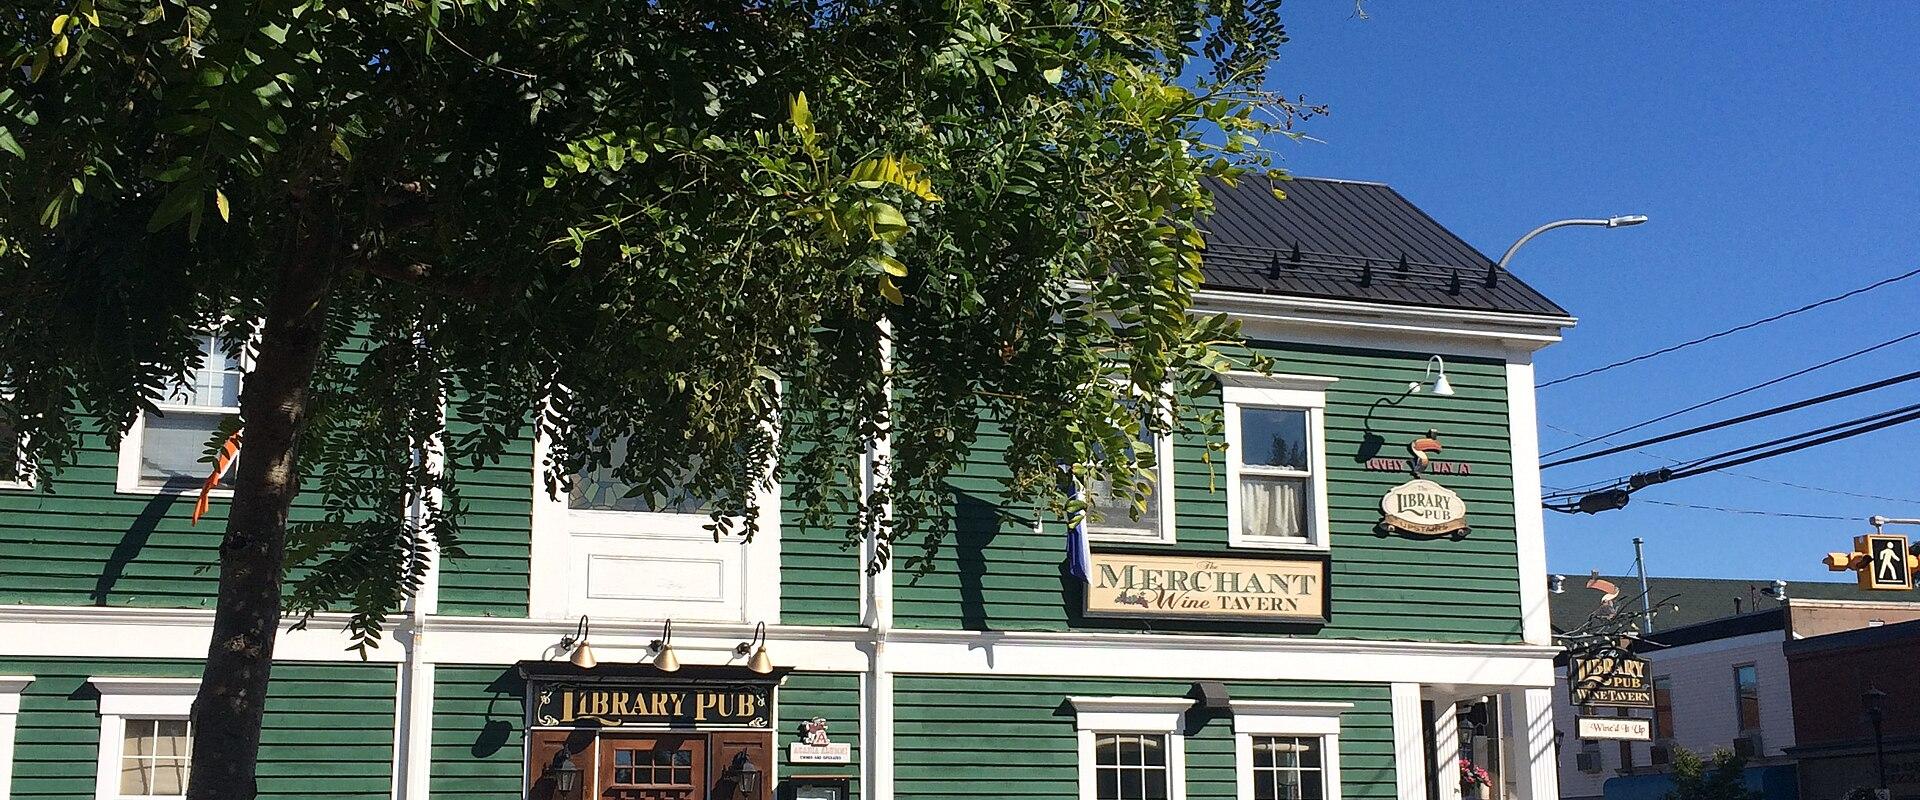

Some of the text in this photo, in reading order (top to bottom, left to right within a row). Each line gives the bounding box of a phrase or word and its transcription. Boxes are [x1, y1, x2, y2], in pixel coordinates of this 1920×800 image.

[1367, 458, 1471, 474] LOVELY DAY AT
[1396, 493, 1451, 516] LIBRARY
[1425, 511, 1451, 520] PUB
[1196, 561, 1218, 571] The
[1096, 563, 1316, 596] MERCHANT
[1154, 587, 1299, 612] Wine TAVERN
[1576, 658, 1645, 685] LIBRARY
[1613, 677, 1642, 688] PUB
[1576, 689, 1650, 702] WINE TAVERN
[560, 689, 756, 726] LIBRARY PUB
